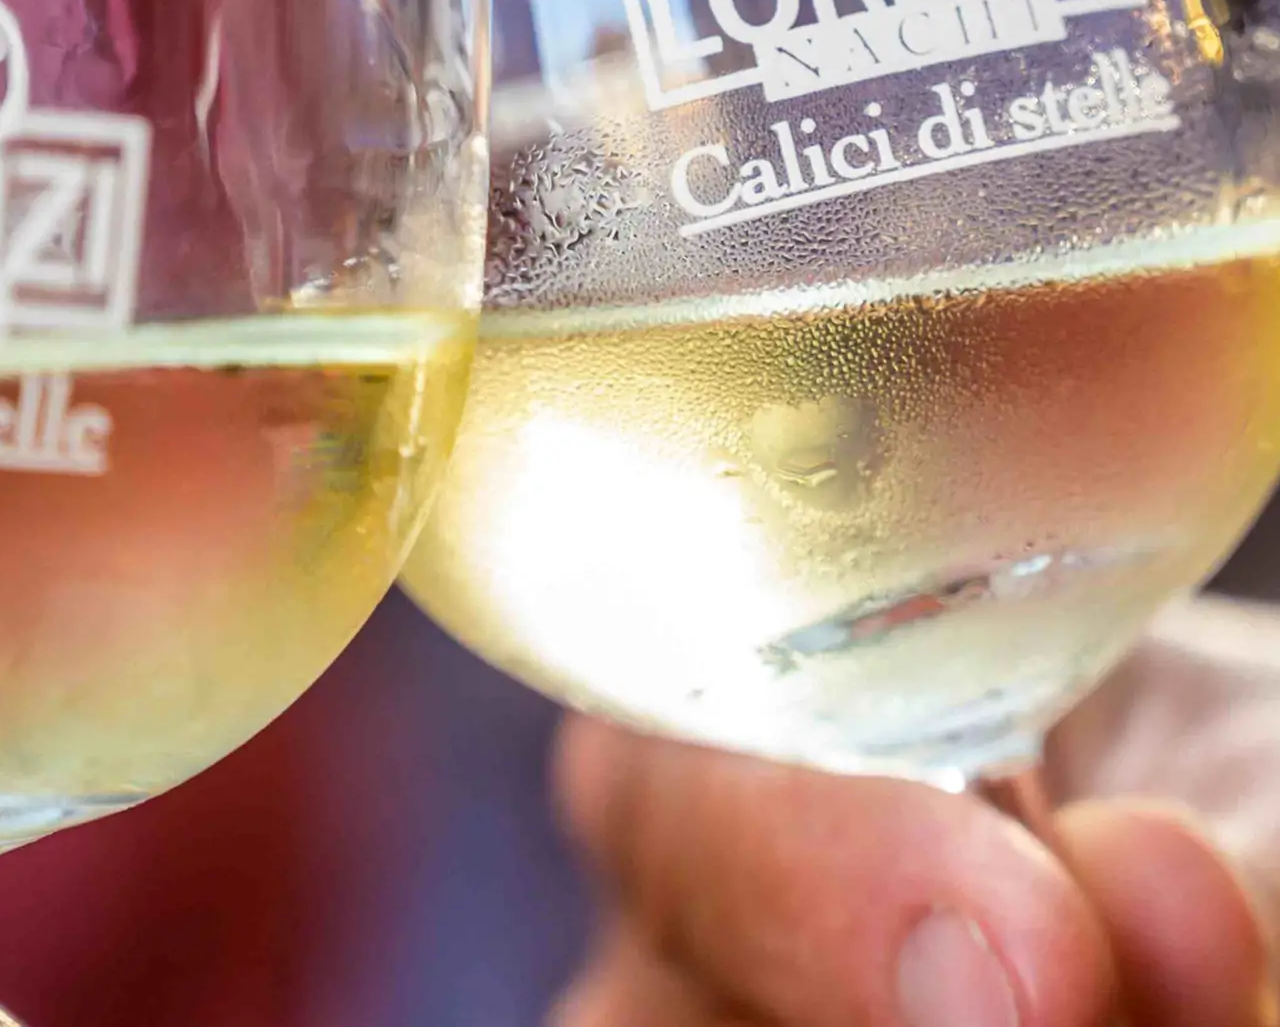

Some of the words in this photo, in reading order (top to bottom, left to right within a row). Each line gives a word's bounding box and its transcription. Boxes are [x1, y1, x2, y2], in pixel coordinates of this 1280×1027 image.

[671, 102, 901, 218] Calici
[918, 80, 994, 160] di
[1010, 48, 1174, 140] stelle
